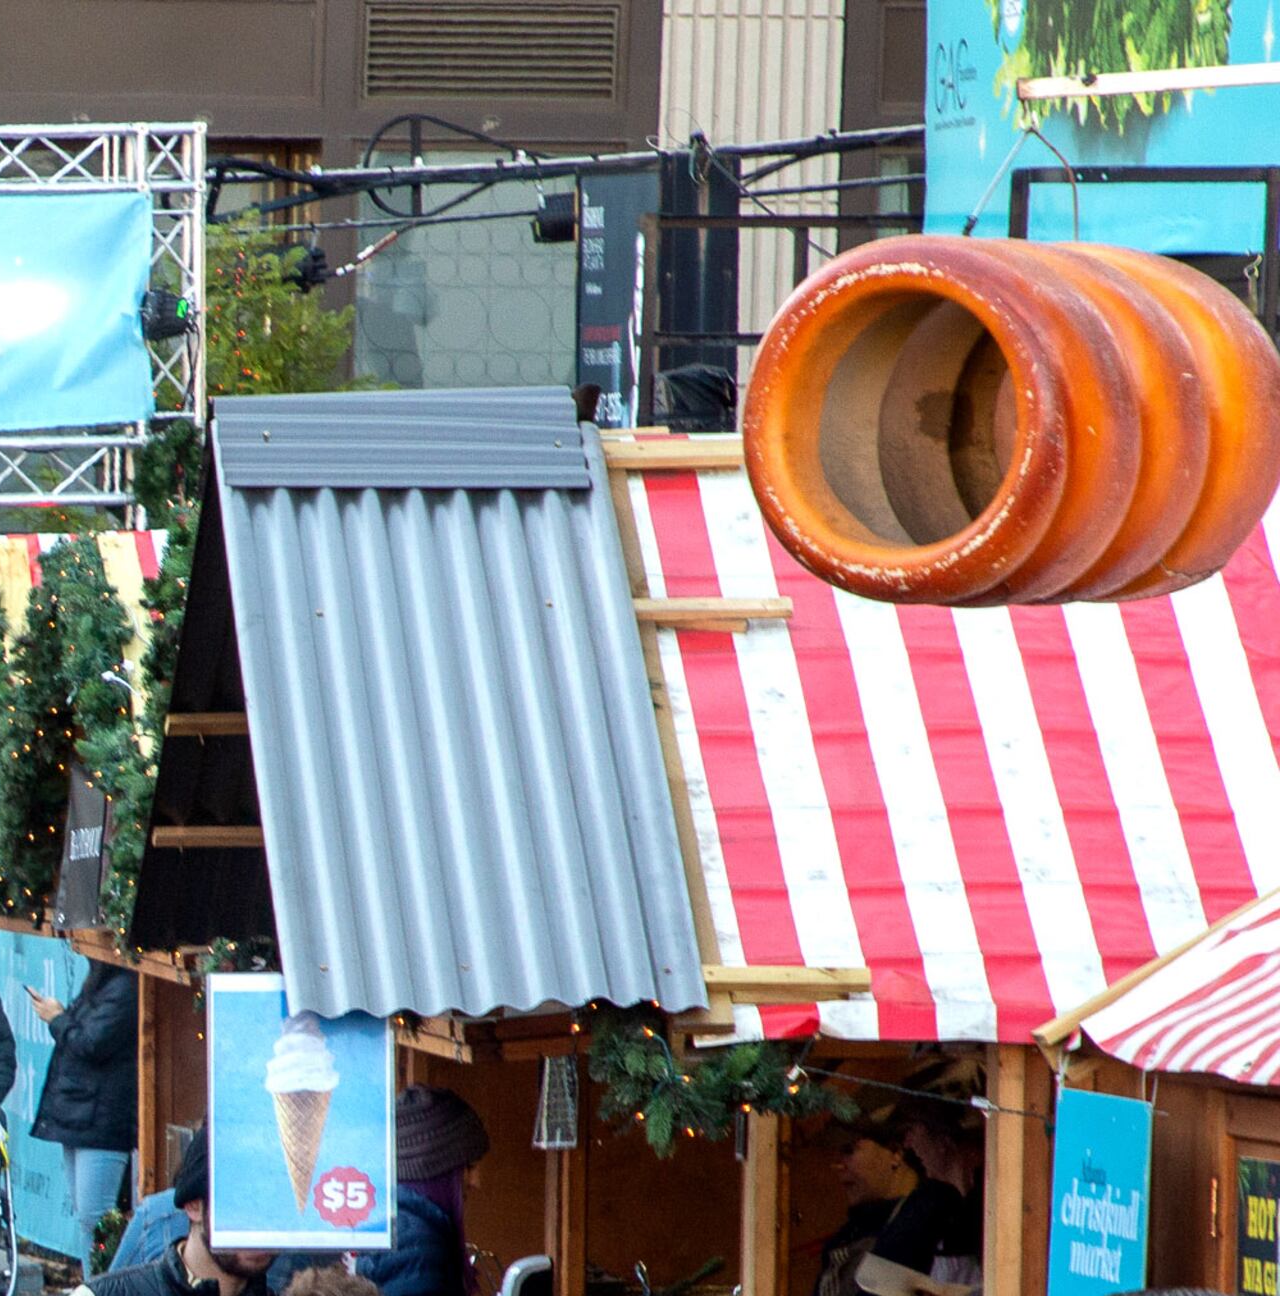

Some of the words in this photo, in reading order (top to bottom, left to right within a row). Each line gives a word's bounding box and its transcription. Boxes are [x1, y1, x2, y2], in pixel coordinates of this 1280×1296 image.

[322, 1177, 369, 1213] $5
[1248, 1195, 1277, 1242] HOT
[1069, 1241, 1122, 1284] market
